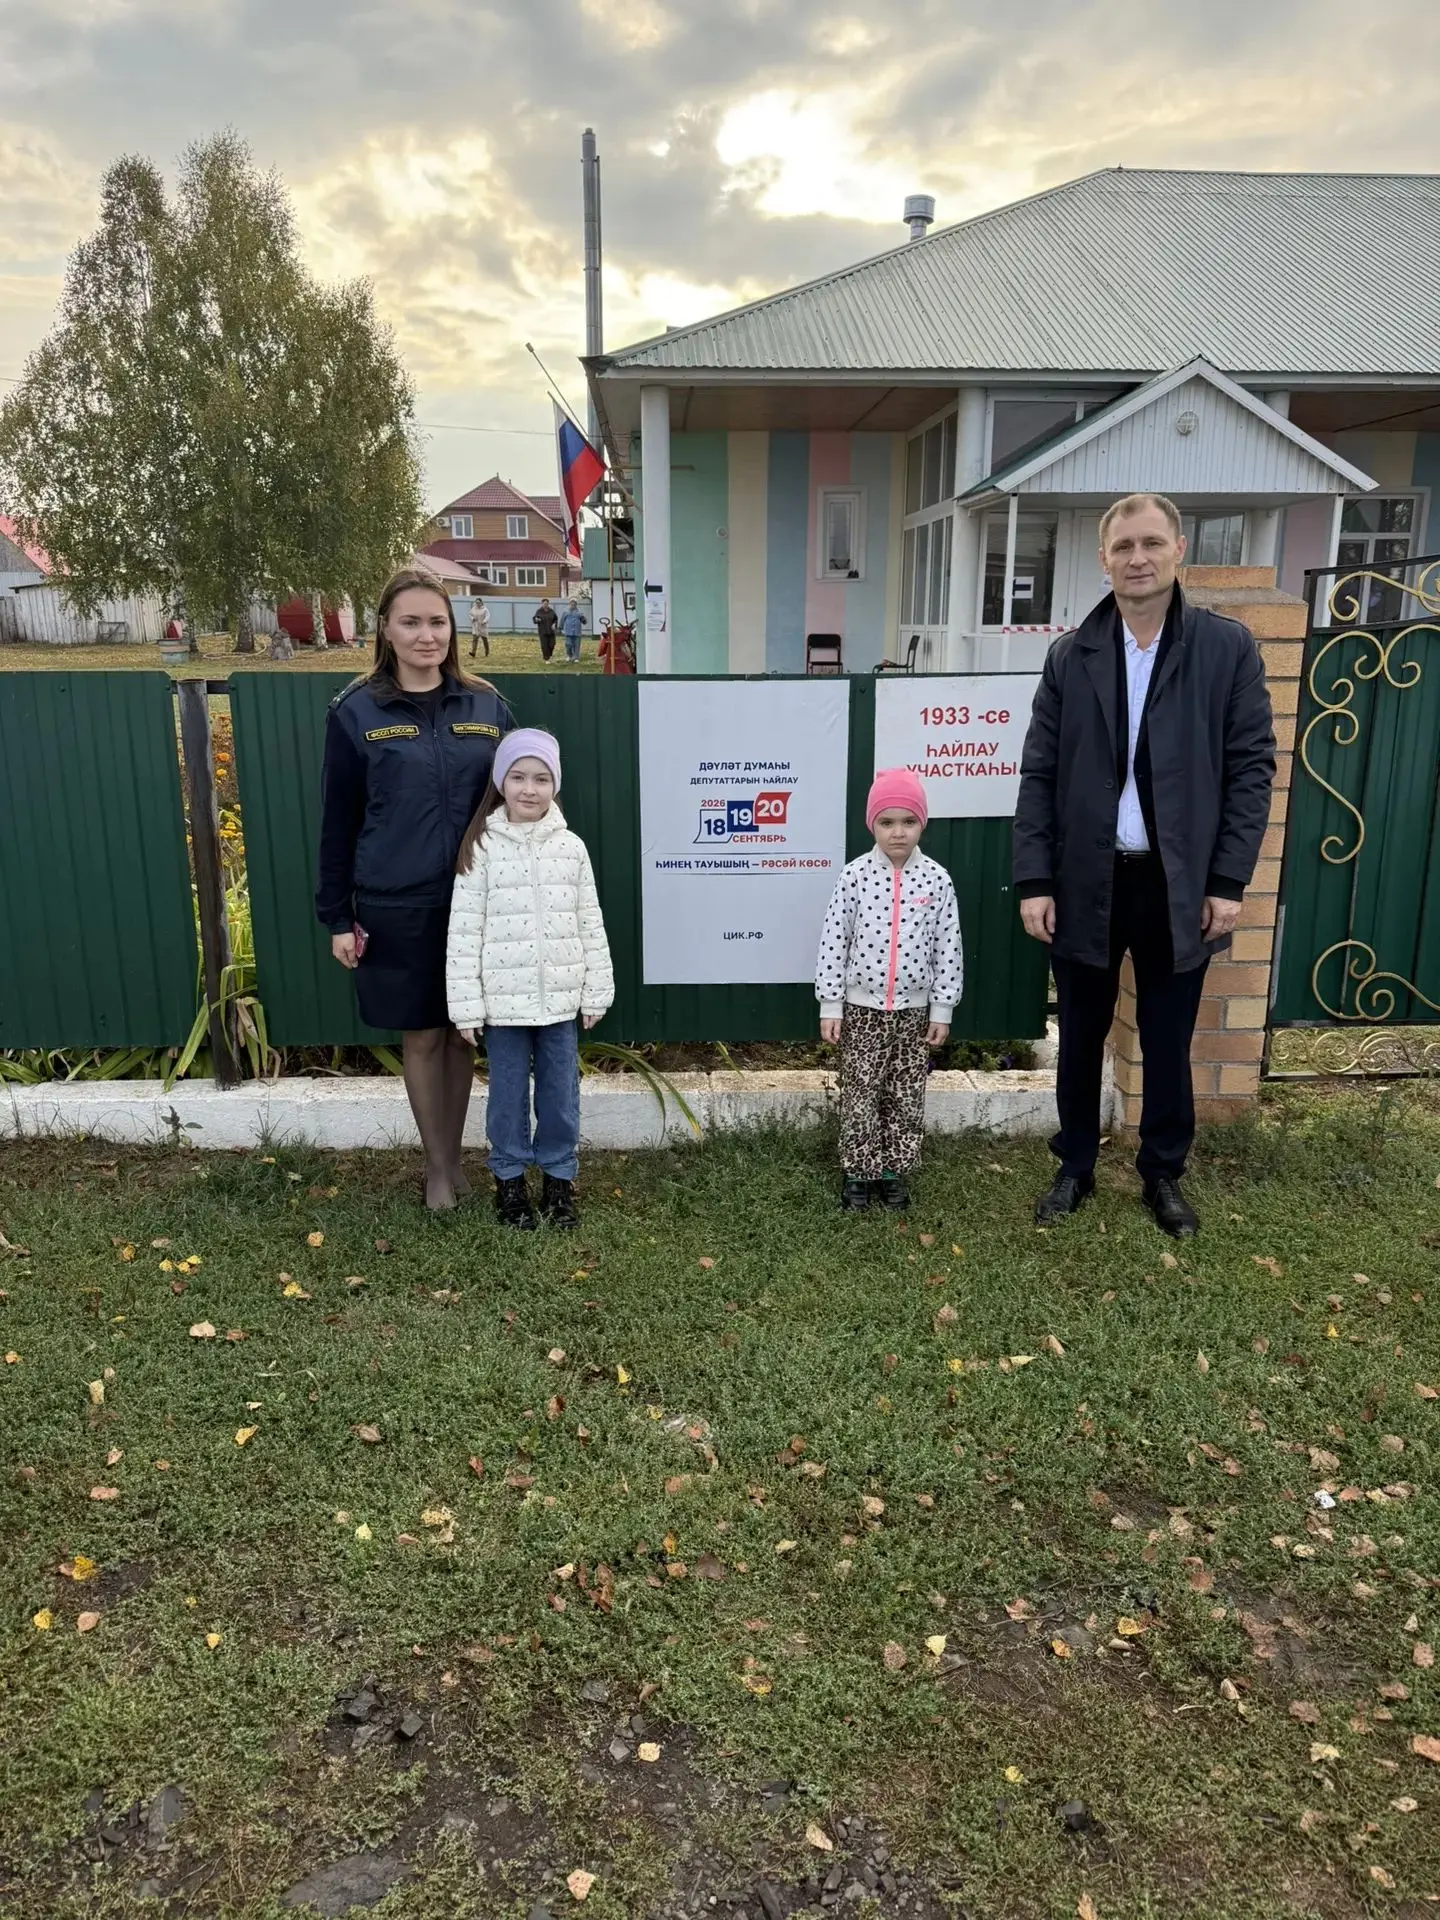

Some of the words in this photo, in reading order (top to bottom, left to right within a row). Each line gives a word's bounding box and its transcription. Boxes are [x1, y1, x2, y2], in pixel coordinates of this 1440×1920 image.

[920, 706, 970, 725] 1933
[978, 709, 1010, 724] -се
[926, 739, 999, 758] ҺАЙЛАУ
[743, 761, 790, 771] ДУМАҺЫ
[689, 777, 760, 785] ДЕПУТАТТАРЫН
[763, 775, 799, 784] ҺАЙЛАУ
[700, 799, 726, 808] 2026
[704, 818, 726, 836] 18
[730, 808, 753, 826] 19
[757, 799, 785, 817] 20
[732, 834, 787, 843] СЕНТЯБРЬ
[655, 860, 692, 869] ҺИНЕҢ
[694, 860, 750, 869] ТАУЫШЫҢ
[761, 858, 797, 868] РӘСӘЙ
[723, 931, 764, 940] ЦИК.РФ
